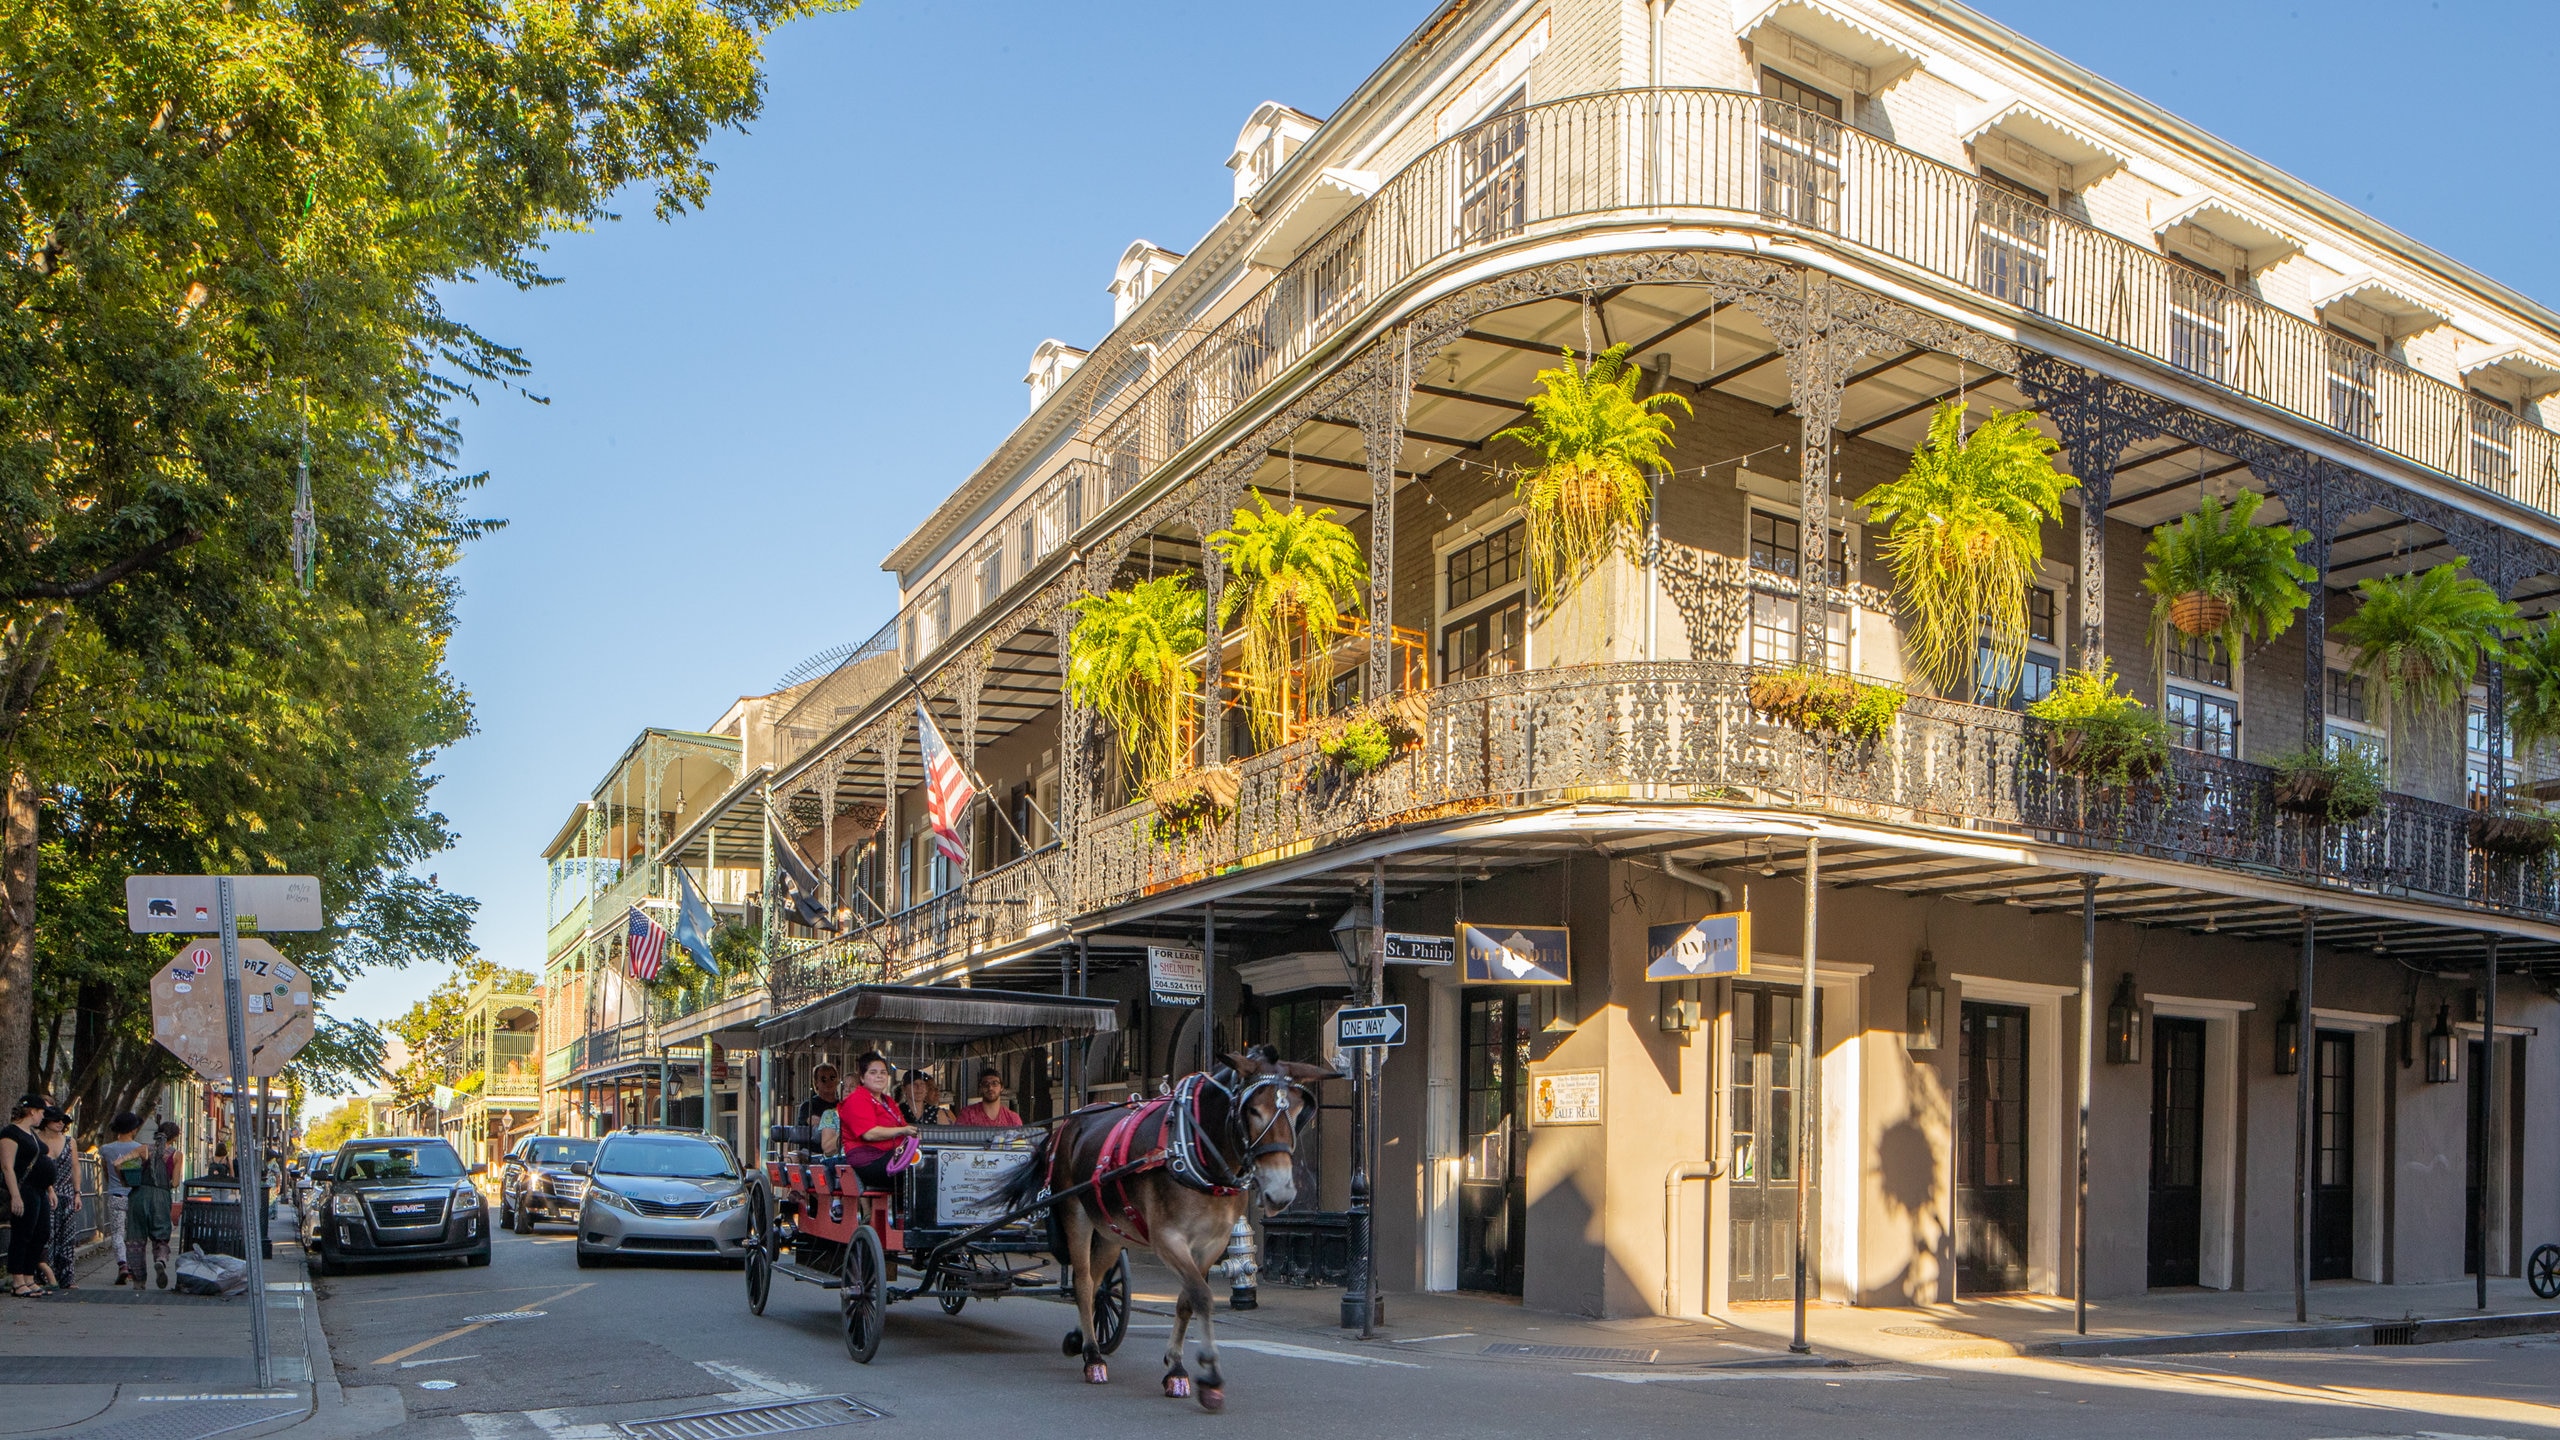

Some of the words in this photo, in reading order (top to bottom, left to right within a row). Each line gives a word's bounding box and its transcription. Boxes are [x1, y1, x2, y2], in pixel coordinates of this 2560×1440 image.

[1154, 950, 1173, 959] FOR
[1174, 952, 1200, 961] LEASE
[1387, 941, 1405, 956] St.
[1411, 943, 1452, 961] Philip
[1154, 980, 1202, 991] 504.524.1111
[1344, 1021, 1362, 1036] ONE
[1365, 1020, 1384, 1034] WAY
[1554, 1106, 1573, 1119] CALLE
[1576, 1106, 1598, 1119] REAL
[391, 1204, 426, 1214] GMC
